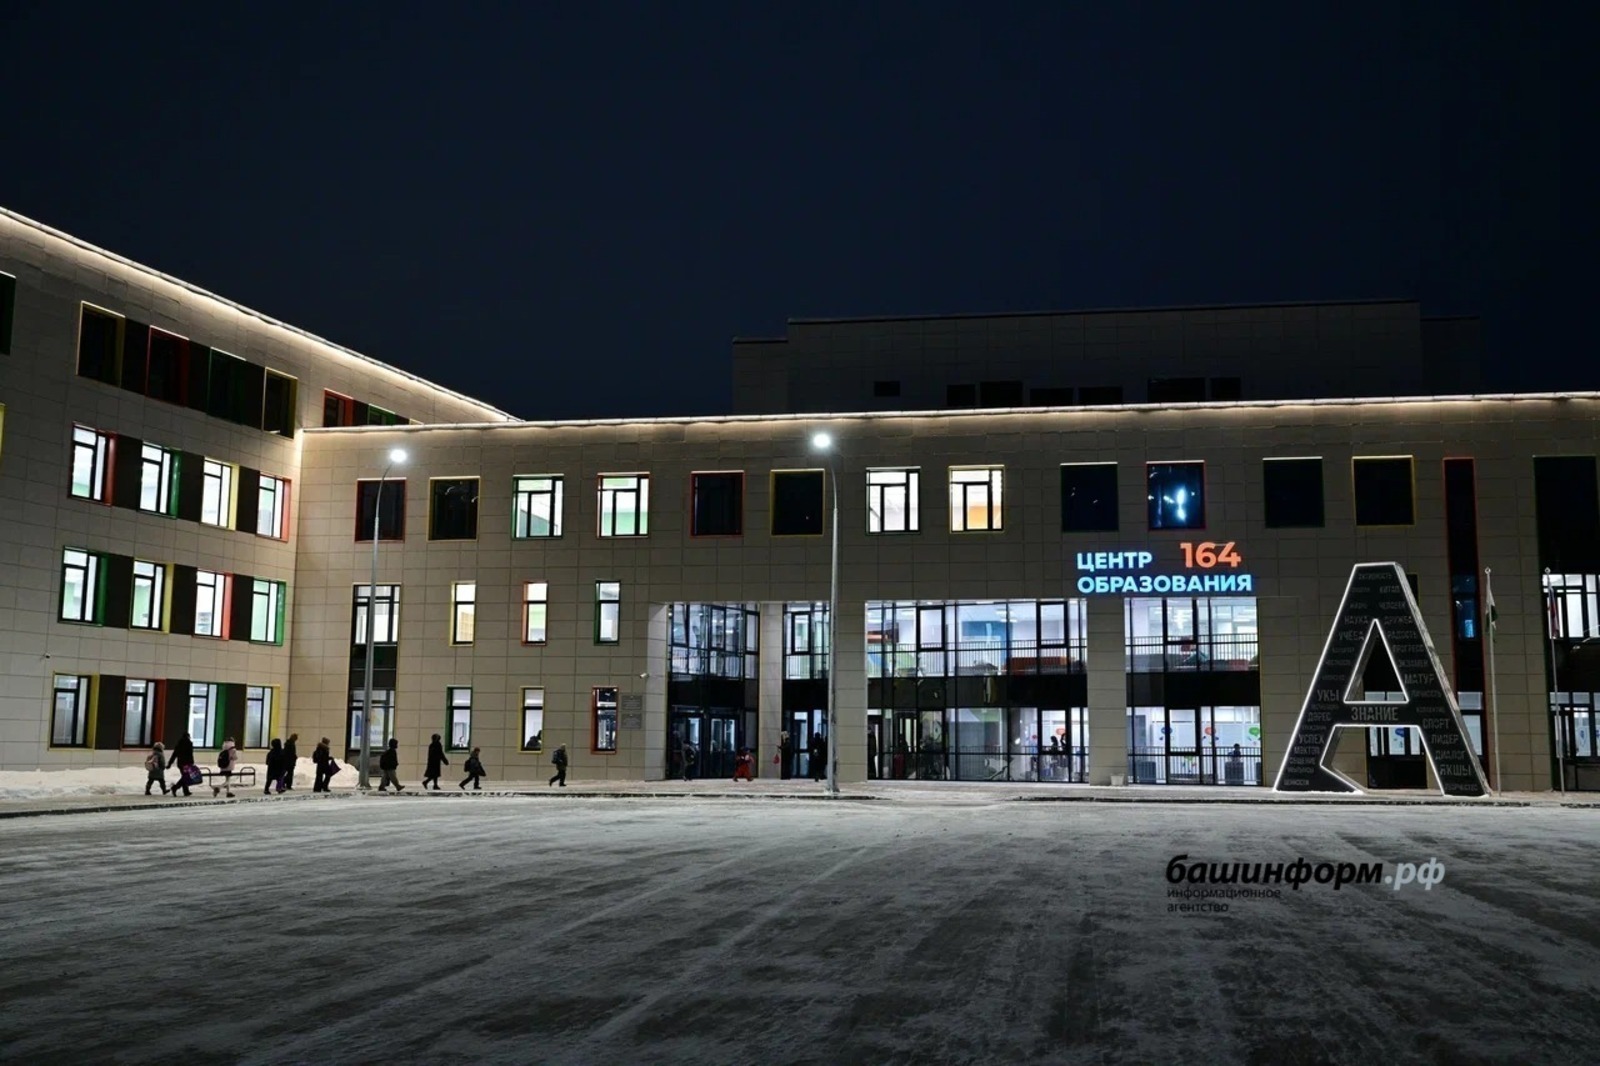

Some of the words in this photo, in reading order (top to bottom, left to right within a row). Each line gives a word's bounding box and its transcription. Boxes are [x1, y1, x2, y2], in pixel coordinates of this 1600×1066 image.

[1077, 552, 1152, 572] ЦЕНТР
[1180, 542, 1242, 568] 164
[1077, 574, 1252, 593] ОБРАЗОВАНИЯ
[1351, 706, 1398, 721] ЗНАНИЕ
[1422, 719, 1450, 730] СПОРТ
[1298, 733, 1325, 744] УСПЕХ
[1431, 733, 1459, 744] ЛИДЕР
